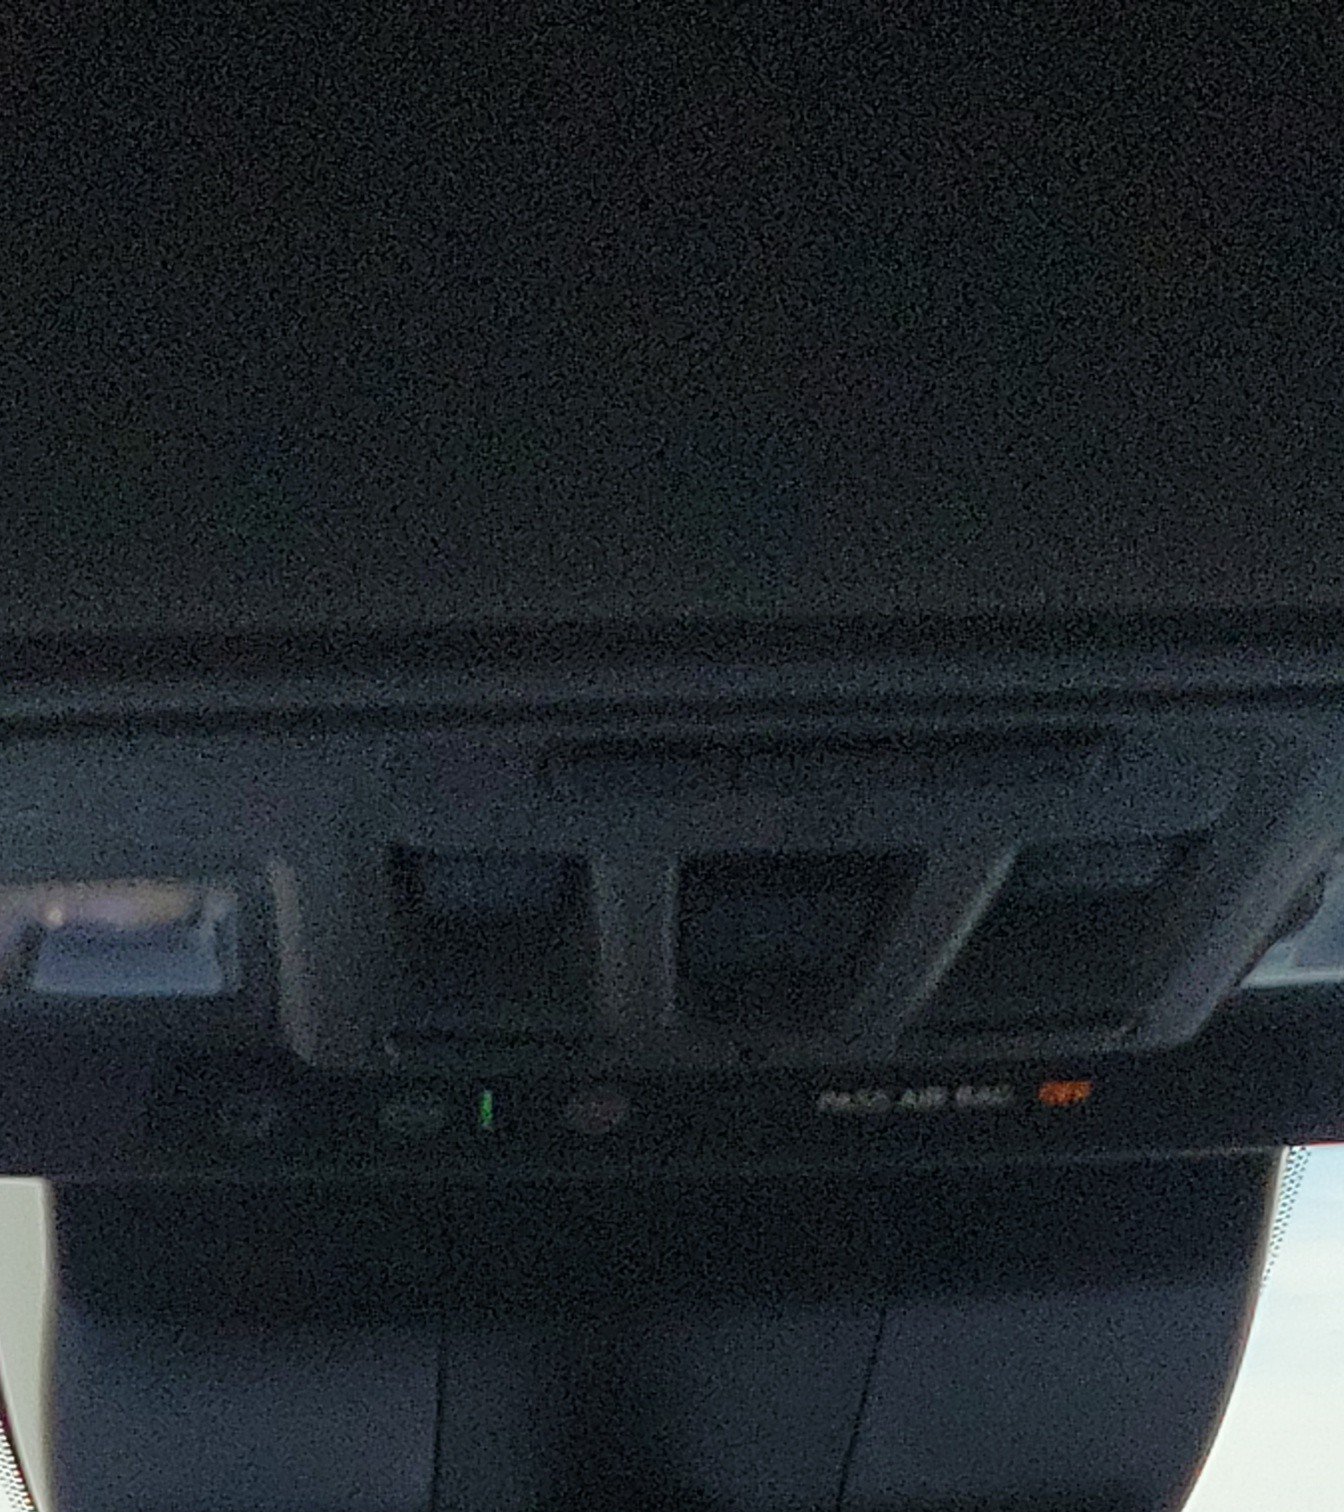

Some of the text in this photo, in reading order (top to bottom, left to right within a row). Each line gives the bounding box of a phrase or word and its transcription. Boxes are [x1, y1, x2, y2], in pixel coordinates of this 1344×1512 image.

[899, 1087, 947, 1110] AIR
[955, 1085, 1013, 1108] BAG
[1037, 1080, 1093, 1106] OFF
